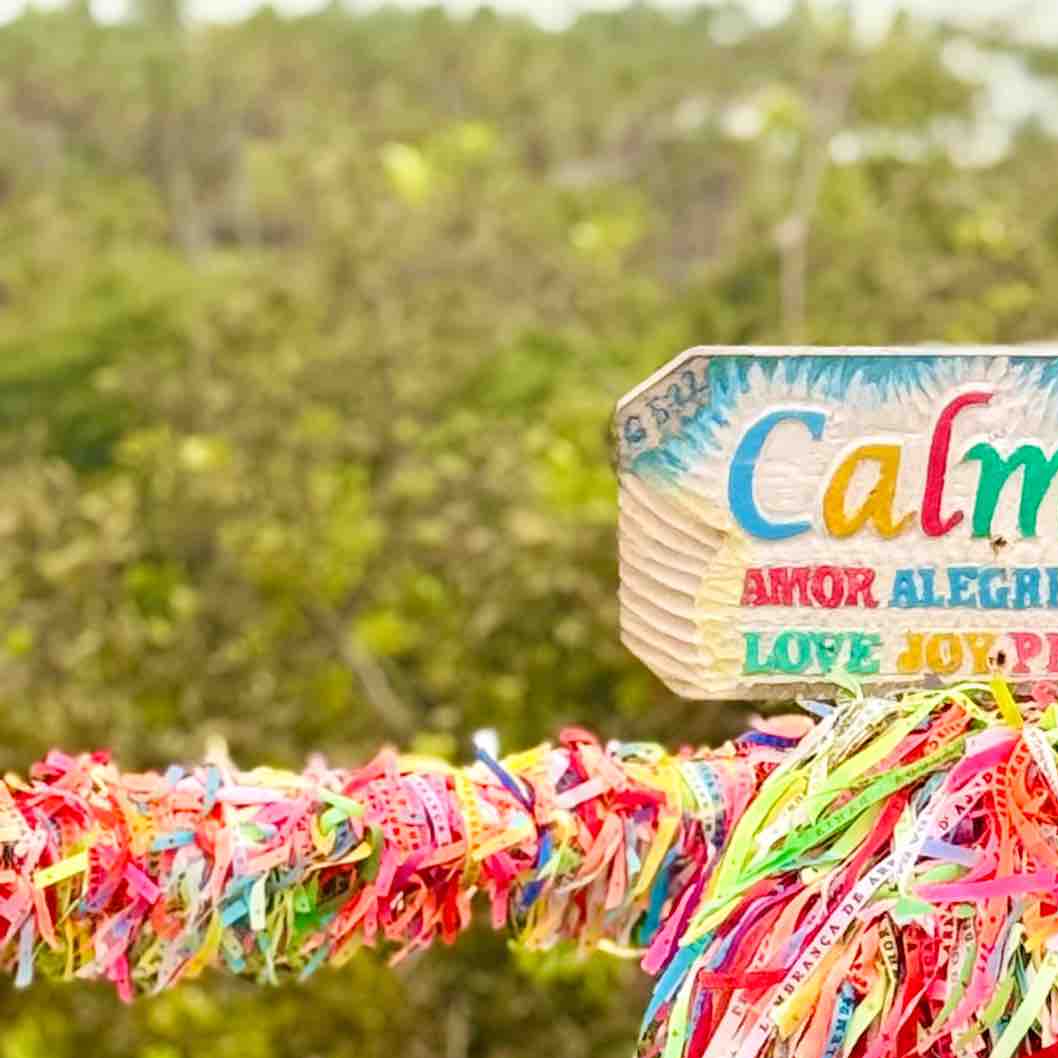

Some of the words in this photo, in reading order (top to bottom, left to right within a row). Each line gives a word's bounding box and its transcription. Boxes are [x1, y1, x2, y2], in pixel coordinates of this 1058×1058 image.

[740, 566, 878, 609] AMOR
[742, 630, 881, 675] LOVE
[896, 632, 996, 675] JOY
[759, 920, 842, 1032] LMBRANÇA
